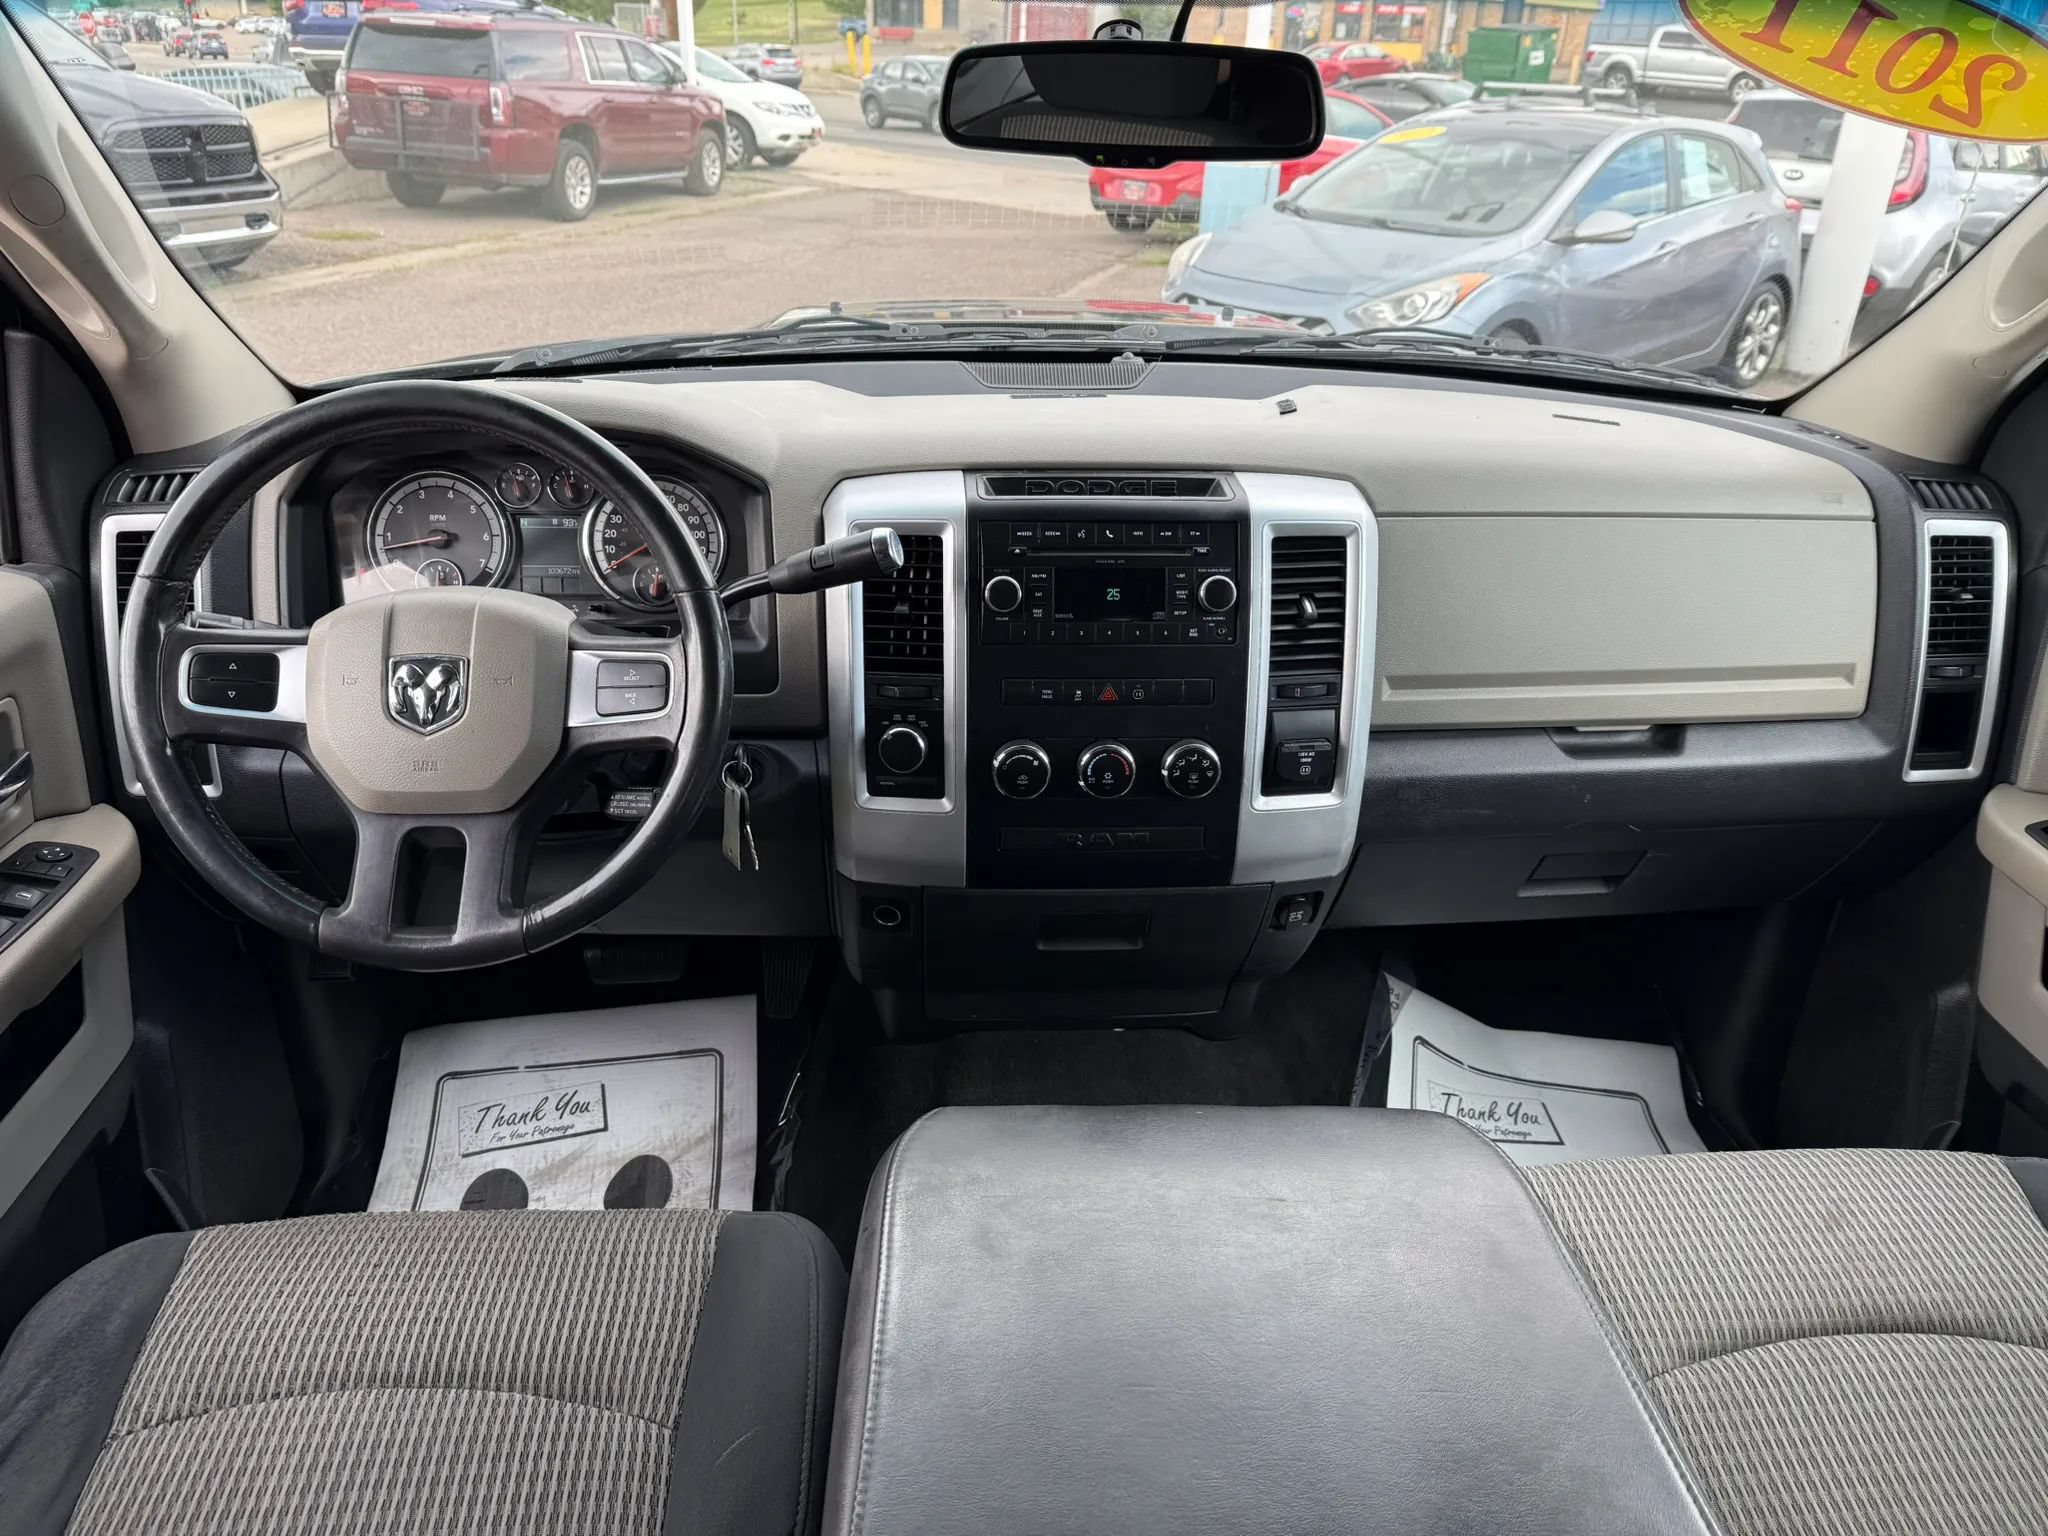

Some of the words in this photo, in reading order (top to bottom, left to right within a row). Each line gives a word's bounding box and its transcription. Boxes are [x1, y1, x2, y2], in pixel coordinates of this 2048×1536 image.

[1026, 480, 1177, 496] DODGE
[418, 490, 426, 500] 3
[447, 490, 454, 499] 4
[396, 505, 404, 514] 2
[469, 505, 477, 514] 5
[677, 504, 689, 512] 80
[429, 514, 446, 522] RPM
[610, 514, 622, 524] 30
[688, 516, 699, 525] 90
[604, 529, 617, 539] 20
[604, 545, 616, 554] 10
[479, 560, 486, 568] 7
[1106, 588, 1120, 601] 25
[475, 1096, 548, 1133] Thank
[555, 1090, 591, 1119] You
[1441, 1092, 1502, 1123] Thank
[1506, 1101, 1542, 1126] You
[490, 1132, 506, 1143] For
[509, 1128, 529, 1140] Your
[532, 1124, 575, 1136] Patronage
